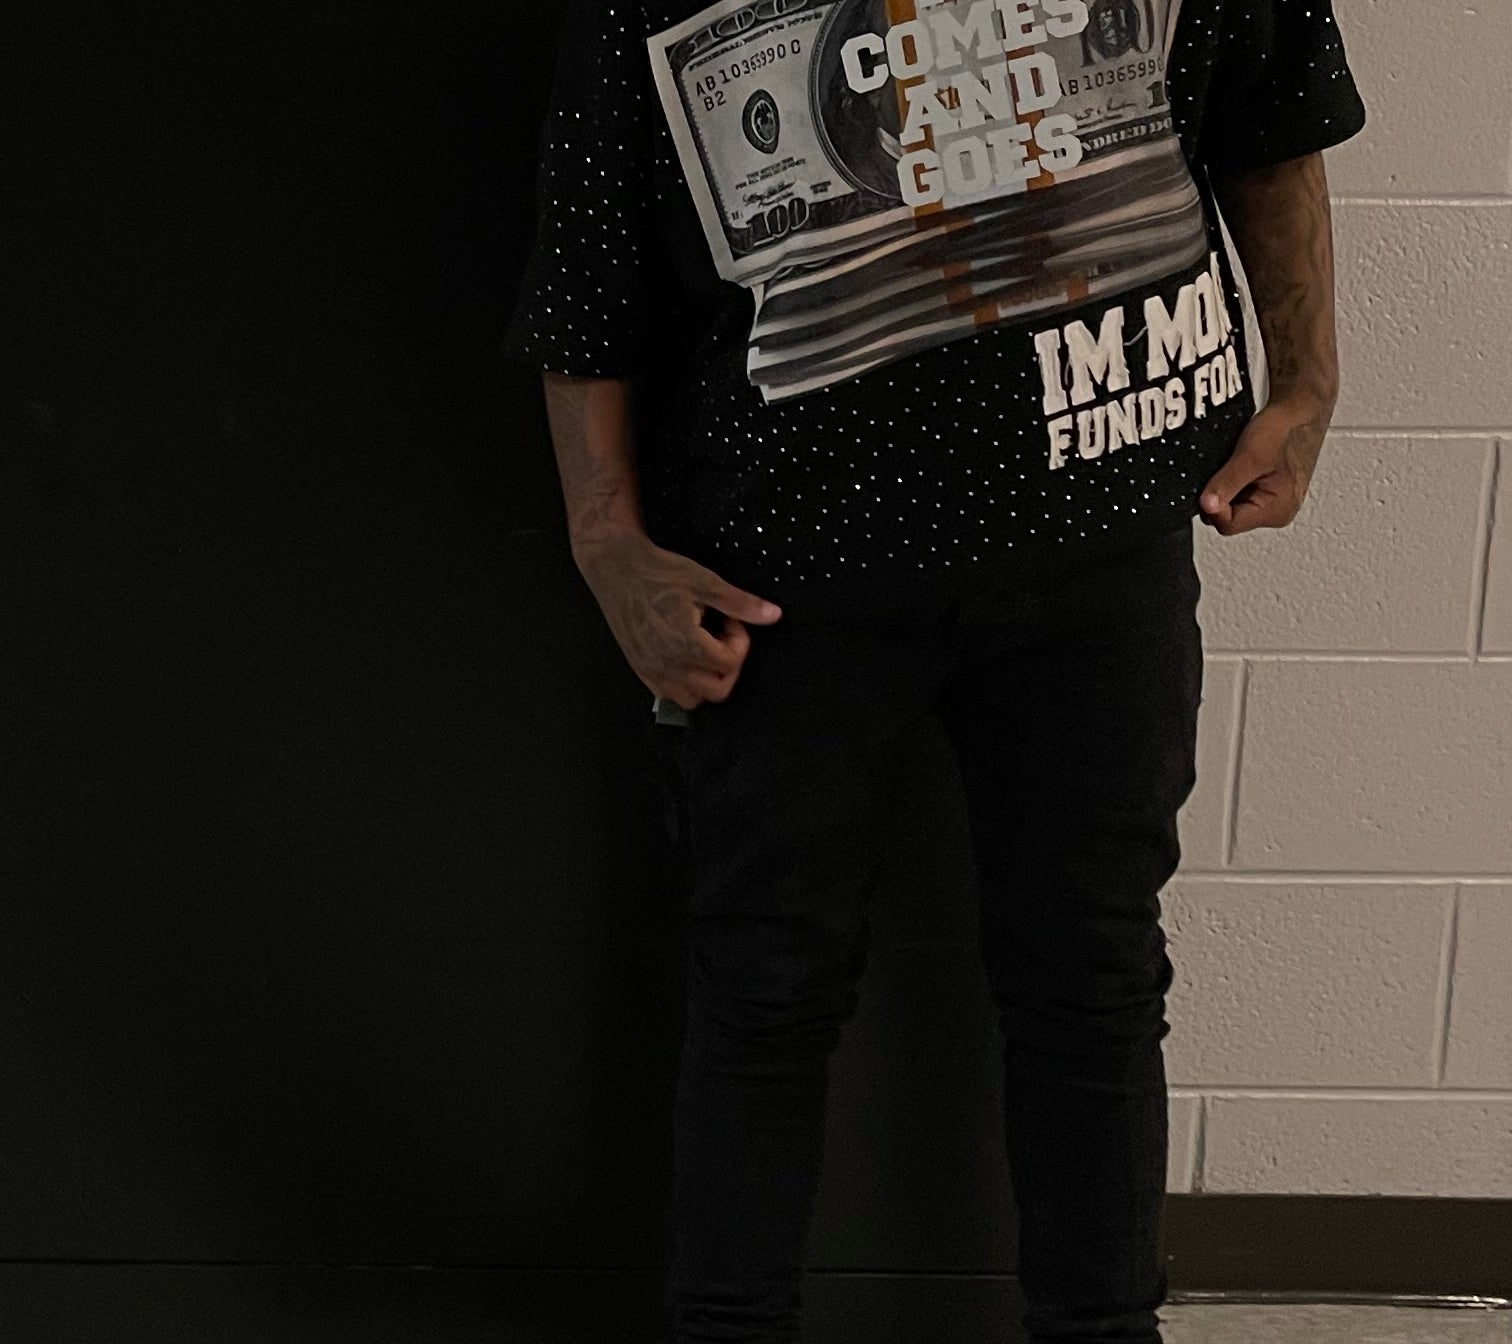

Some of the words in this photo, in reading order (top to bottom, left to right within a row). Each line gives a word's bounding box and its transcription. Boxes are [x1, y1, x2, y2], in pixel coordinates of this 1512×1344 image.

[899, 51, 1062, 146] AND
[896, 112, 1083, 208] GOES
[1034, 306, 1131, 416] IM
[1047, 377, 1187, 471] FUNDS
